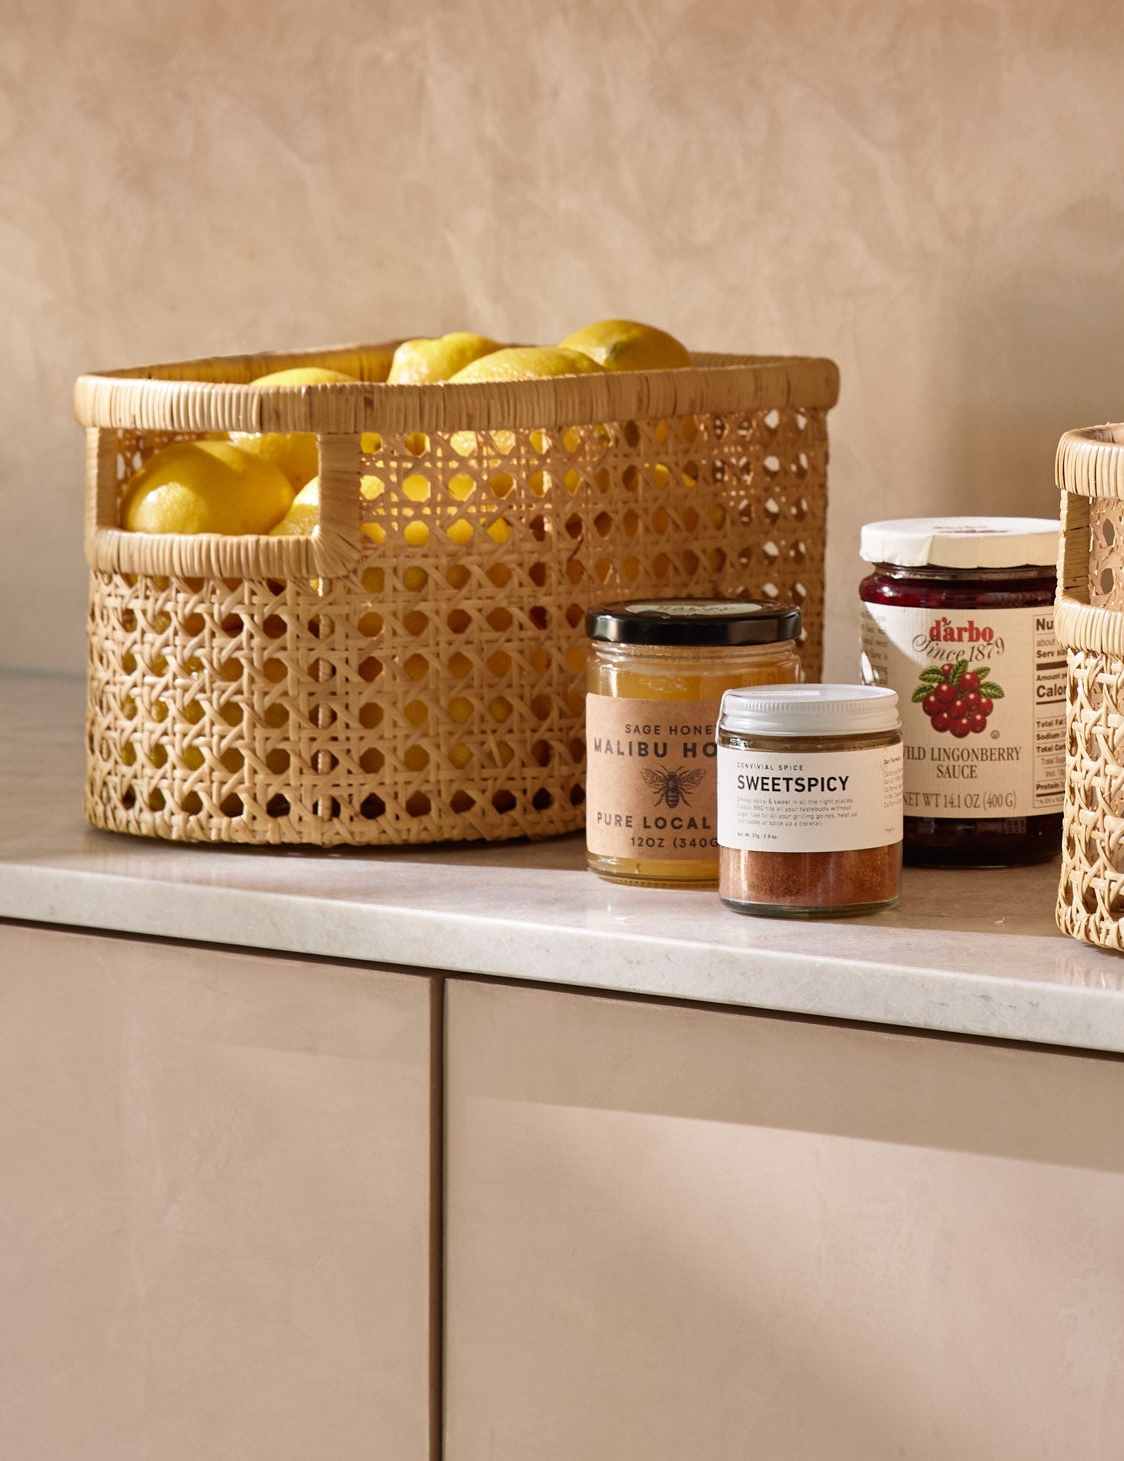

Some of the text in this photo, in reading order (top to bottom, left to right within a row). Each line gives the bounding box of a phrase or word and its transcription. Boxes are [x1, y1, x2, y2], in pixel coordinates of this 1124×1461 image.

[911, 634, 1006, 663] Since 1879
[1036, 649, 1055, 658] Serv
[625, 724, 714, 736] SAGE HONE
[1036, 719, 1053, 728] Total
[593, 738, 668, 758] MALIBU
[931, 746, 1022, 762] LINGONBERRY
[1036, 745, 1053, 753] Total
[737, 762, 774, 771] CONVIVIAL
[936, 764, 978, 779] SAUCE
[737, 775, 850, 793] SWEETSPICY
[903, 791, 920, 807] NET
[922, 792, 941, 808] WT
[944, 793, 961, 808] 14.1
[963, 793, 981, 809] OZ
[982, 790, 1004, 811] (400
[1005, 790, 1018, 810] G)
[597, 812, 712, 829] PURE LOCAL
[631, 836, 719, 849] 12OZ (340G
